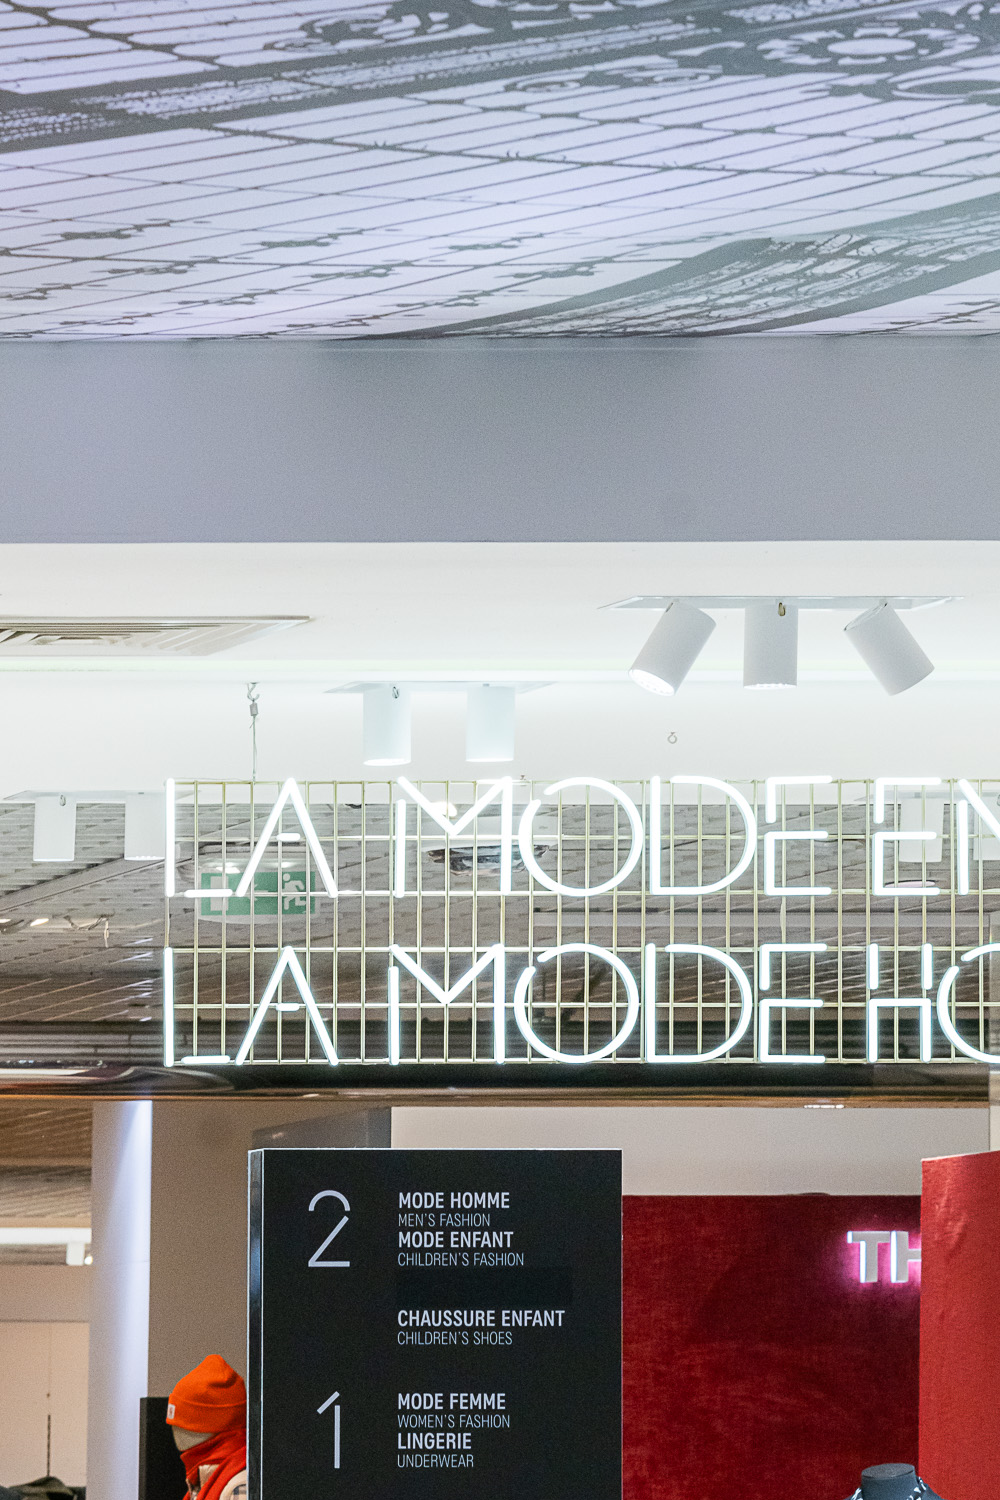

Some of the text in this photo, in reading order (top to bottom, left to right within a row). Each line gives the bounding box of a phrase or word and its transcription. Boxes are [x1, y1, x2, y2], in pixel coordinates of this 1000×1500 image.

[165, 776, 339, 898] LA
[394, 775, 833, 897] MODE
[163, 945, 339, 1067] LA
[388, 943, 827, 1066] MODE
[399, 1192, 510, 1209] MODE HOMME
[308, 1190, 350, 1267] 2
[398, 1213, 491, 1227] MEN'S FASHION
[398, 1231, 514, 1248] MODE ENFANT
[398, 1252, 525, 1267] CHILDREN'S FASHION
[398, 1310, 566, 1327] CHAUSSURE ENFANT
[397, 1331, 513, 1345] CHILDREN'S SHOES
[398, 1393, 506, 1410] MODE FEMME
[397, 1414, 510, 1428] WOMEN'S FASHION
[316, 1391, 341, 1469] 1
[398, 1432, 472, 1449] LINGERIE
[397, 1454, 474, 1468] UNDERWEAR
